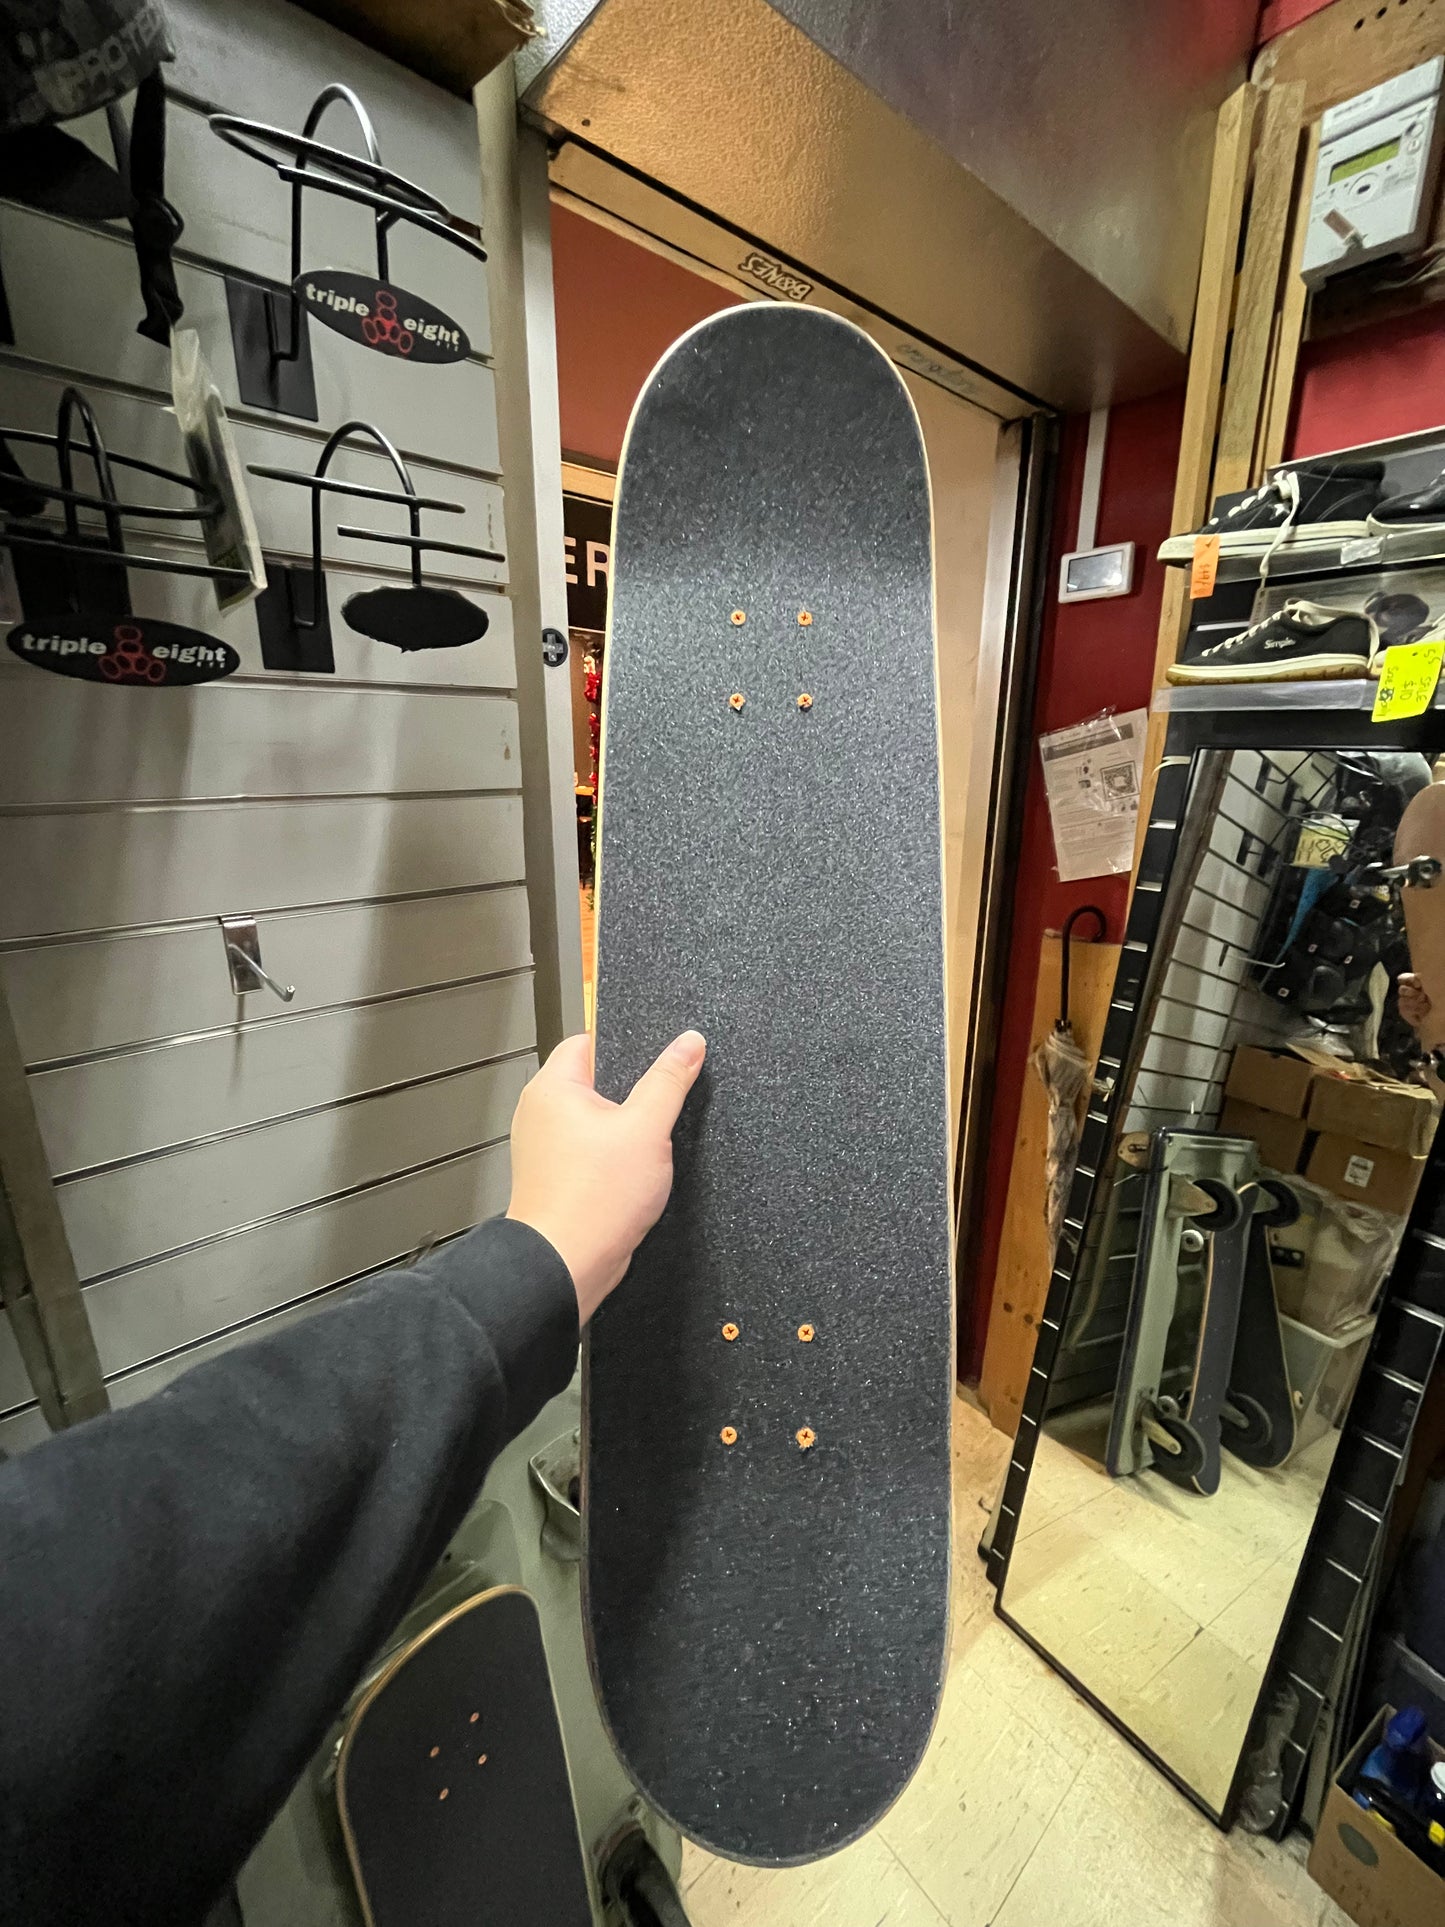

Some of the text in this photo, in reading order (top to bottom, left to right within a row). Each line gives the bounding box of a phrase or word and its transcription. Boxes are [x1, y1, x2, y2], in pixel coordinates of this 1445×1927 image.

[305, 283, 460, 345] triple eight
[22, 634, 226, 663] triple eight
